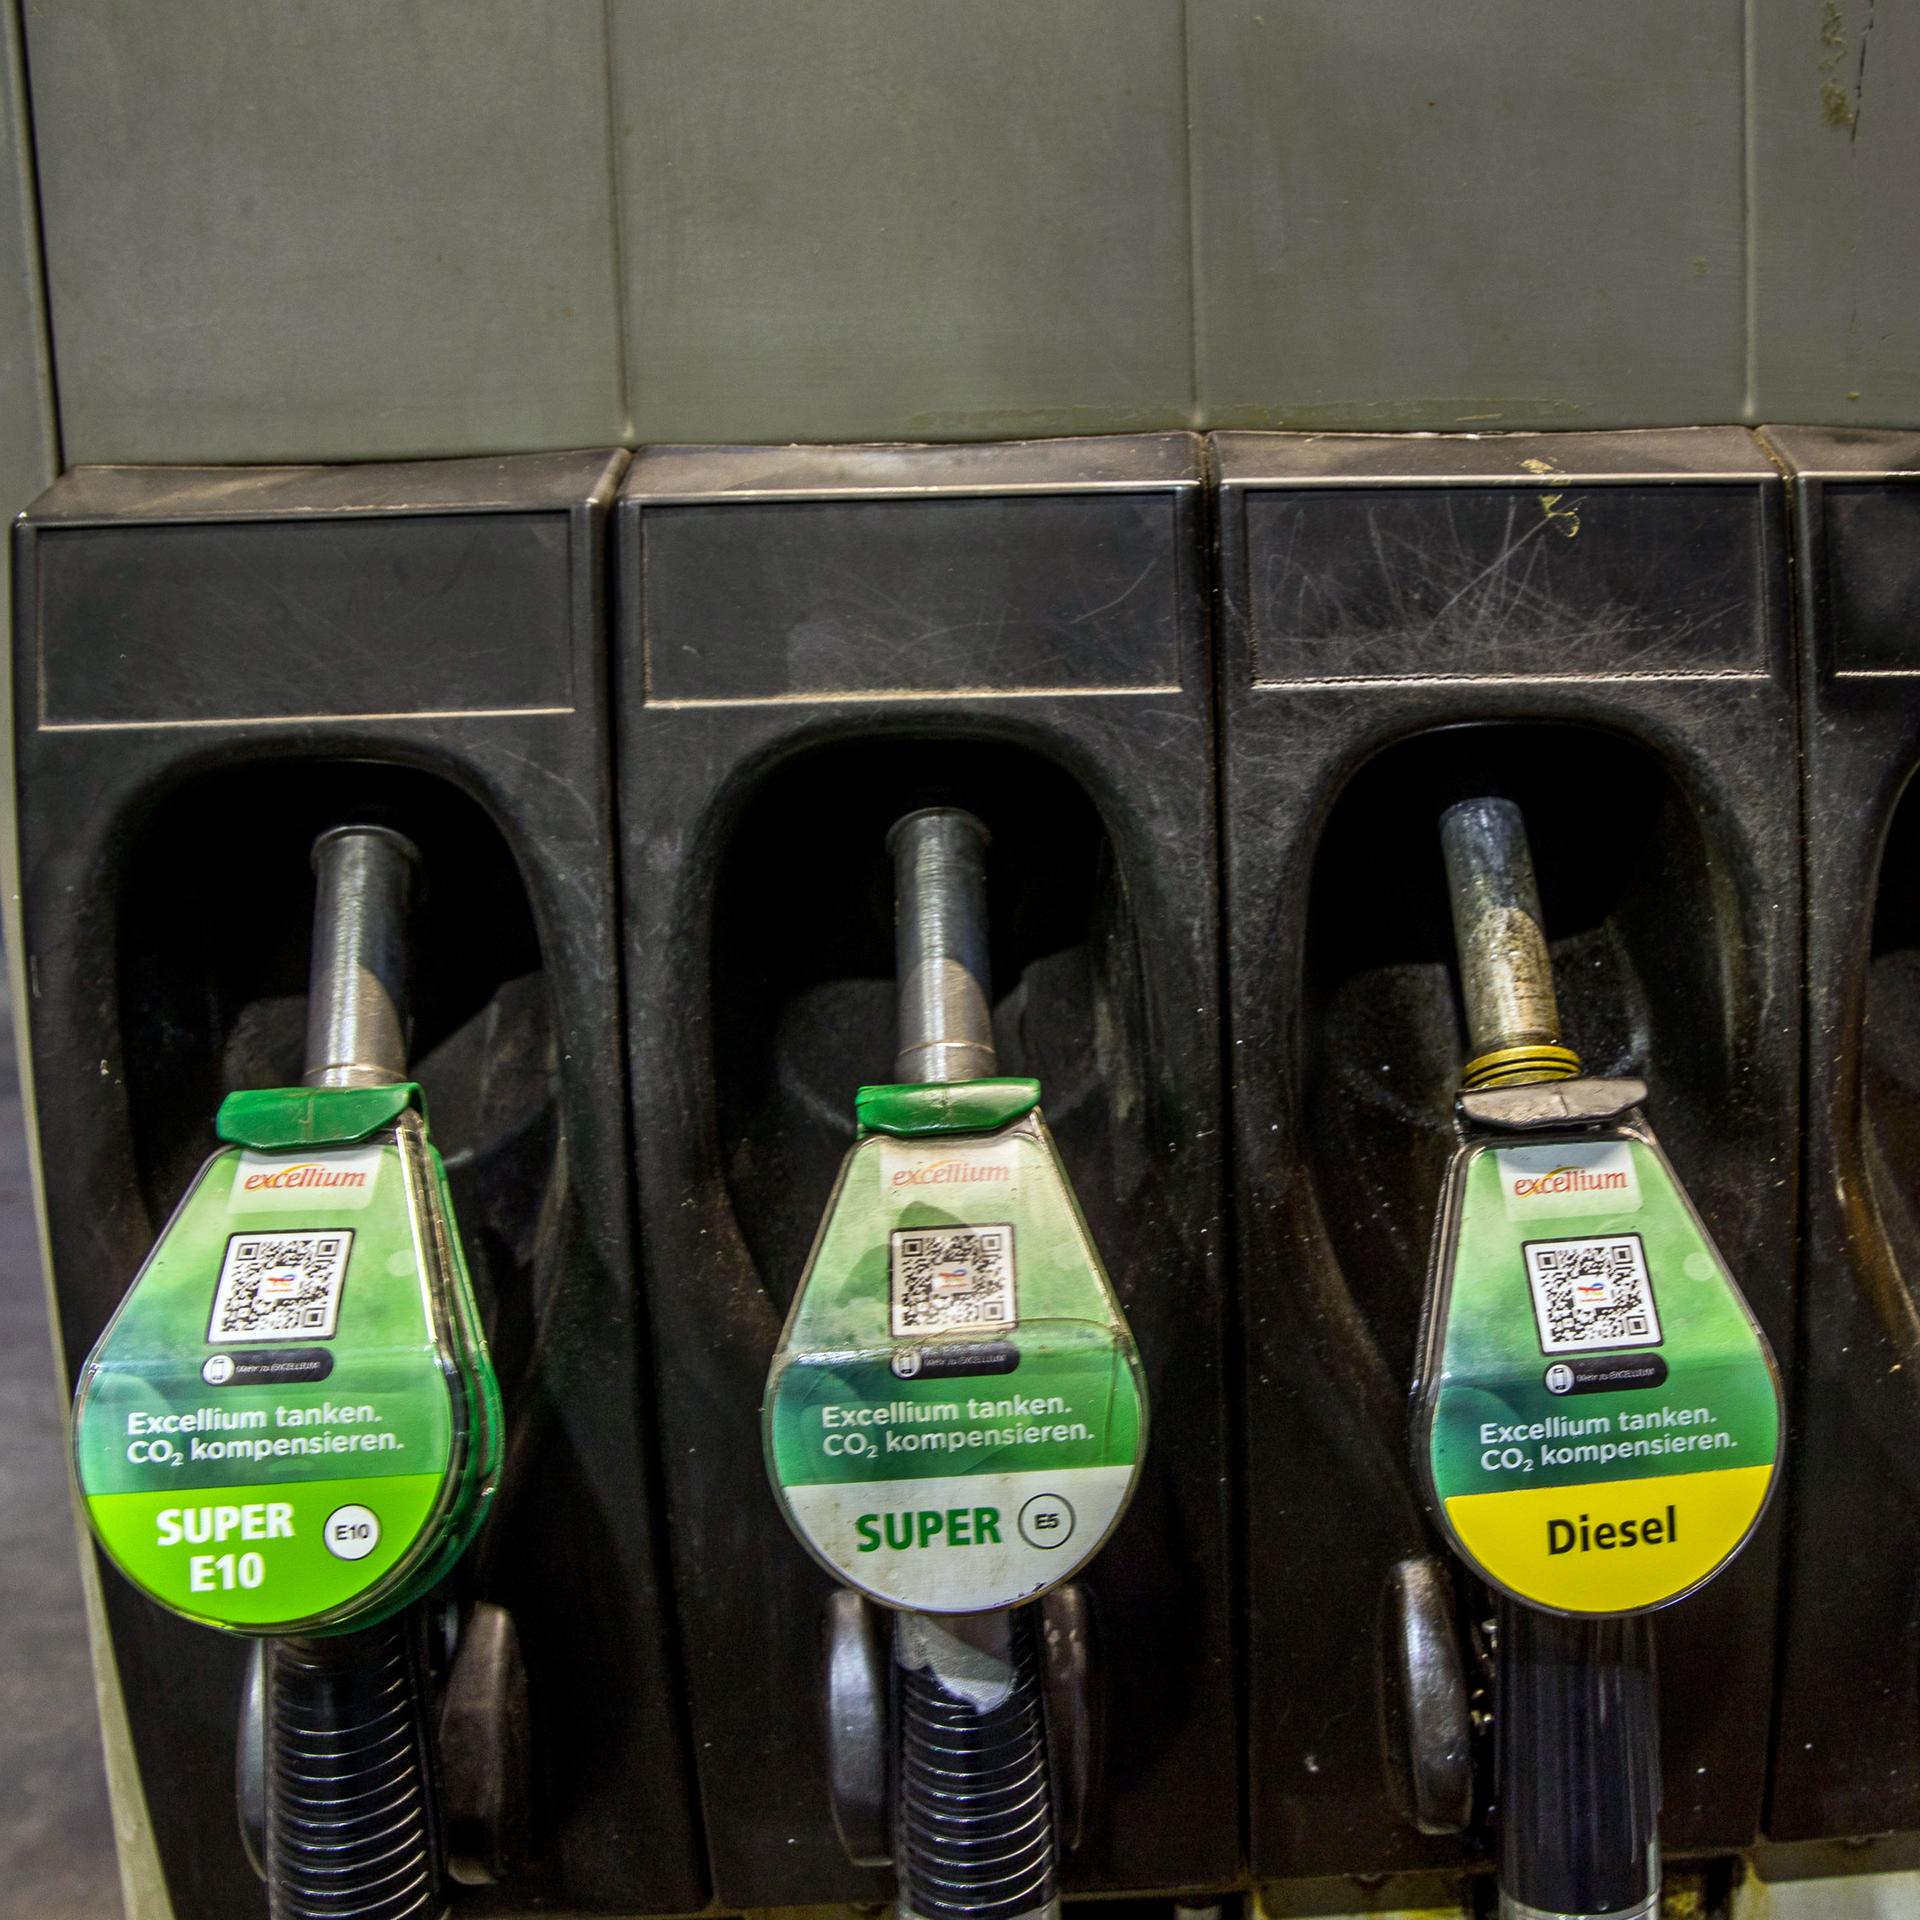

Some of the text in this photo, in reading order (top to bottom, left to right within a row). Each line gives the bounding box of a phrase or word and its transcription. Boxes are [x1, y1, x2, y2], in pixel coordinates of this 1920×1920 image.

[243, 1163, 367, 1191] excellium
[891, 1160, 1010, 1187] excellium
[1514, 1166, 1628, 1197] excellium
[127, 1402, 383, 1436] Excellium tanken.
[821, 1394, 1073, 1429] Excellium tanken.
[1479, 1406, 1718, 1445] Excellium tanken.
[190, 1429, 405, 1461] kompensieren.
[886, 1422, 1096, 1454] kompensieren.
[1541, 1431, 1738, 1466] kompensieren.
[156, 1502, 295, 1547] SUPER
[335, 1523, 370, 1541] E10
[856, 1507, 1001, 1552] SUPER
[1034, 1512, 1060, 1530] E5
[1547, 1505, 1678, 1555] Diesel
[189, 1553, 265, 1593] E10
